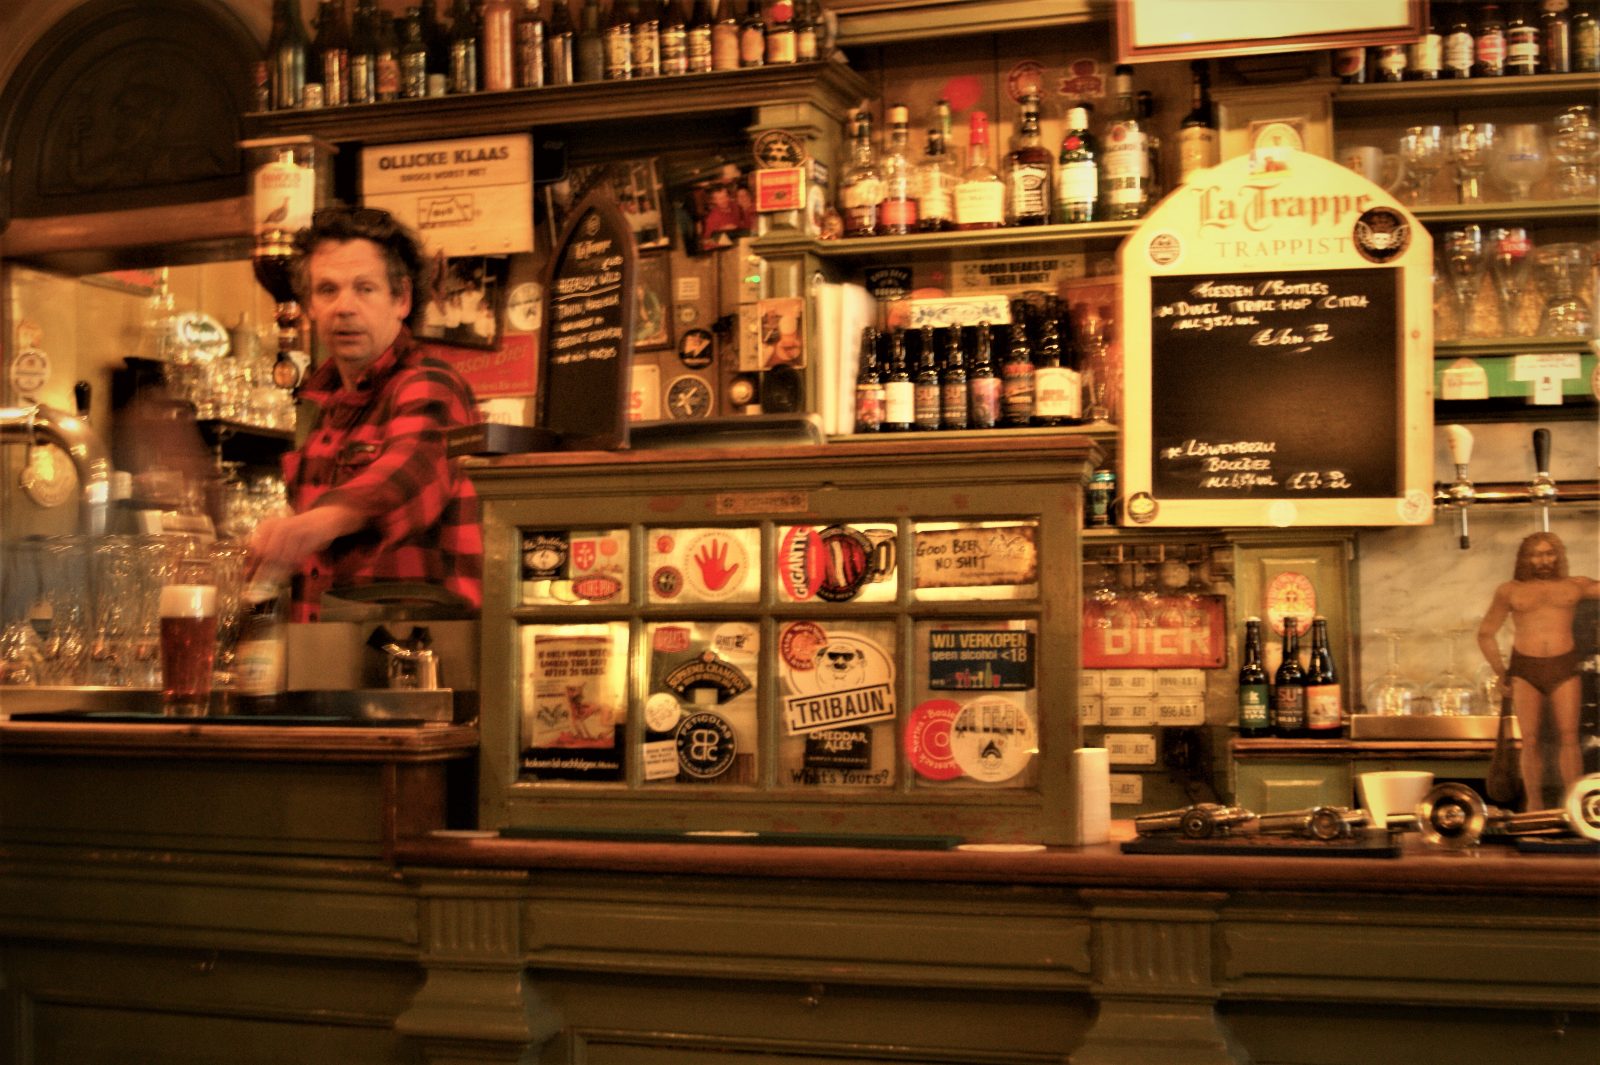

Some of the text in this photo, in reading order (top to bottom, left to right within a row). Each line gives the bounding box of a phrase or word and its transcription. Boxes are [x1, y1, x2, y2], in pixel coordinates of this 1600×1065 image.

[454, 146, 509, 164] KLAAS
[1192, 182, 1372, 232] La Trappe
[1215, 237, 1351, 258] TRAPPIST
[1178, 302, 1220, 315] DUVEL
[1281, 299, 1312, 310] HOP
[1322, 296, 1370, 309] CITRA
[916, 539, 983, 557] GOOD BEER
[790, 526, 809, 599] GIGANTIC
[935, 554, 993, 571] NO SHIT
[932, 633, 1028, 649] WIJ VERKOPEN
[1103, 609, 1212, 656] BIER
[932, 651, 958, 661] geen
[960, 649, 998, 660] alcohol
[706, 663, 747, 691] CHAMPION
[796, 692, 885, 725] TRIBAUN
[680, 715, 732, 738] PETICOLAS
[809, 731, 868, 744] CHEDDAR
[824, 740, 853, 754] ALES
[790, 768, 889, 785] What's Yours?
